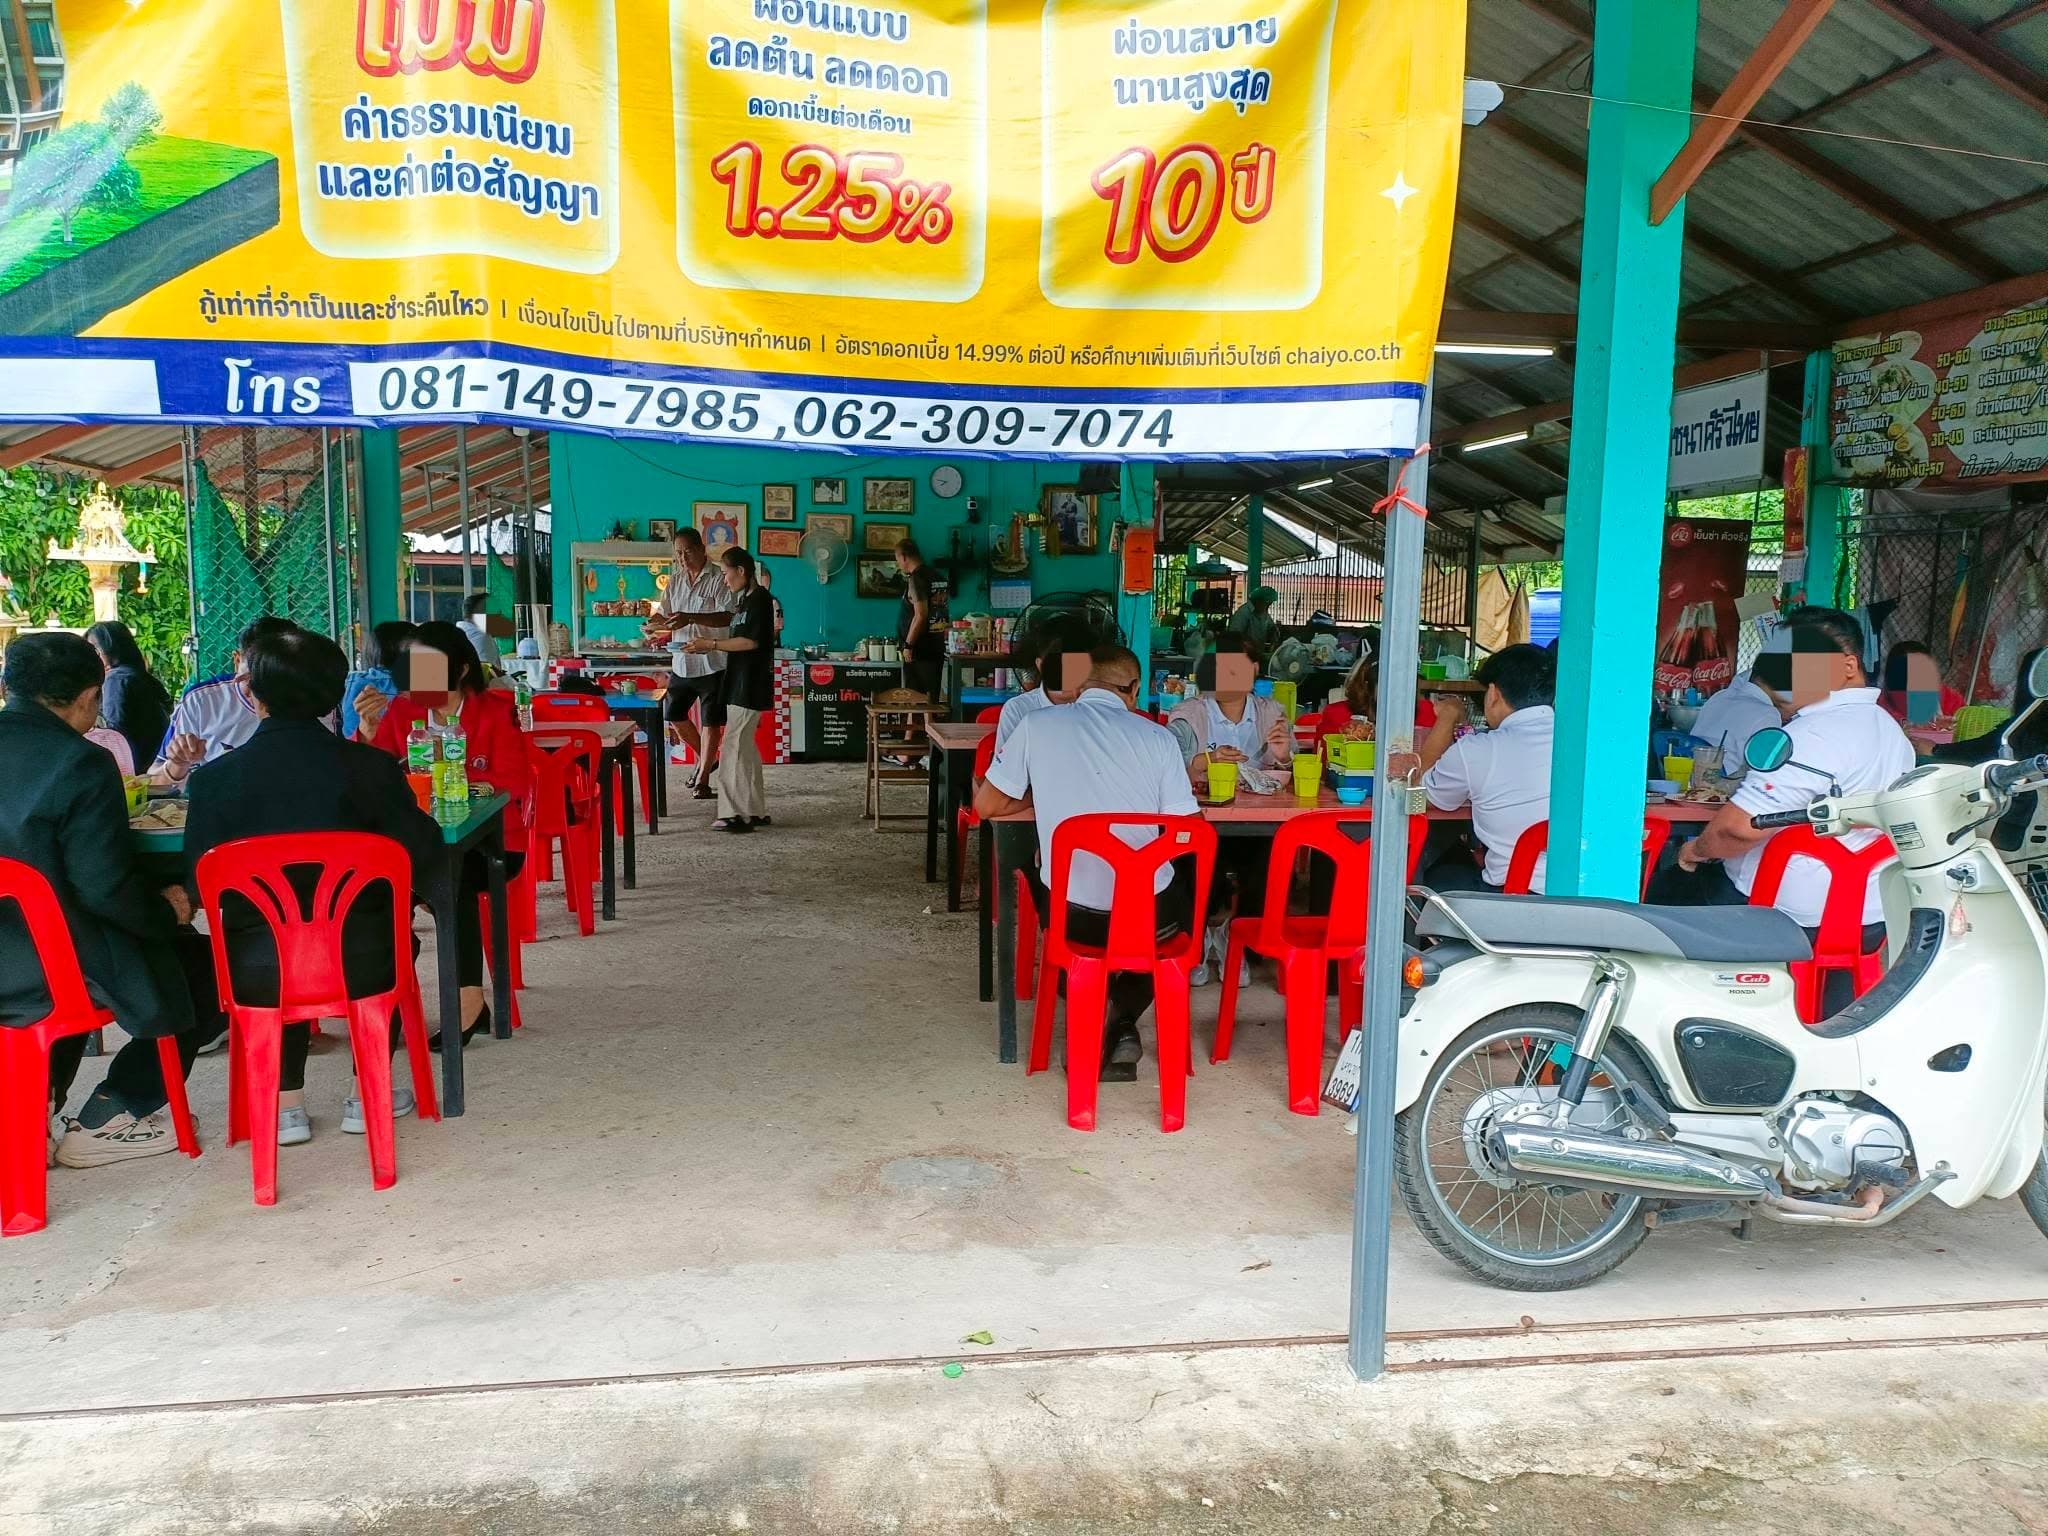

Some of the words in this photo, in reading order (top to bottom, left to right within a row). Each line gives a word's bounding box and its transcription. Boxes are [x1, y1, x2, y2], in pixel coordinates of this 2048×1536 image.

[1114, 17, 1277, 54] ผ่อนสบาย
[709, 36, 814, 80] ลดต้น
[825, 56, 949, 97] ลดดอก
[1114, 68, 1270, 113] นานสูงสุด
[343, 97, 571, 157] ค่าธรรมเนียม
[749, 94, 911, 134] ดอกเบี้ยต่อเดือน
[319, 153, 600, 223] และค่าต่อสัญญา
[710, 140, 953, 244] 1.25%
[199, 289, 489, 323] กู้เท่าที่จำเป็นและชำระคืนไหว
[518, 298, 811, 352] เงื่อนไขเป็นไปตามที่บริษัทฯกำหนด
[835, 334, 949, 360] อัตราดอกเบี้ย
[954, 343, 1023, 363] 14.99%
[1028, 343, 1065, 365] ต่อปี
[1070, 343, 1281, 367] หรือศึกษาเพิ่มเติมที่เว็บไซต์
[1286, 342, 1401, 365] chaiyo.co.th
[224, 358, 320, 415] โทร
[379, 364, 761, 432] 081-149-7985
[1740, 974, 1767, 984] Cub
[1328, 1077, 1355, 1103] 3969
